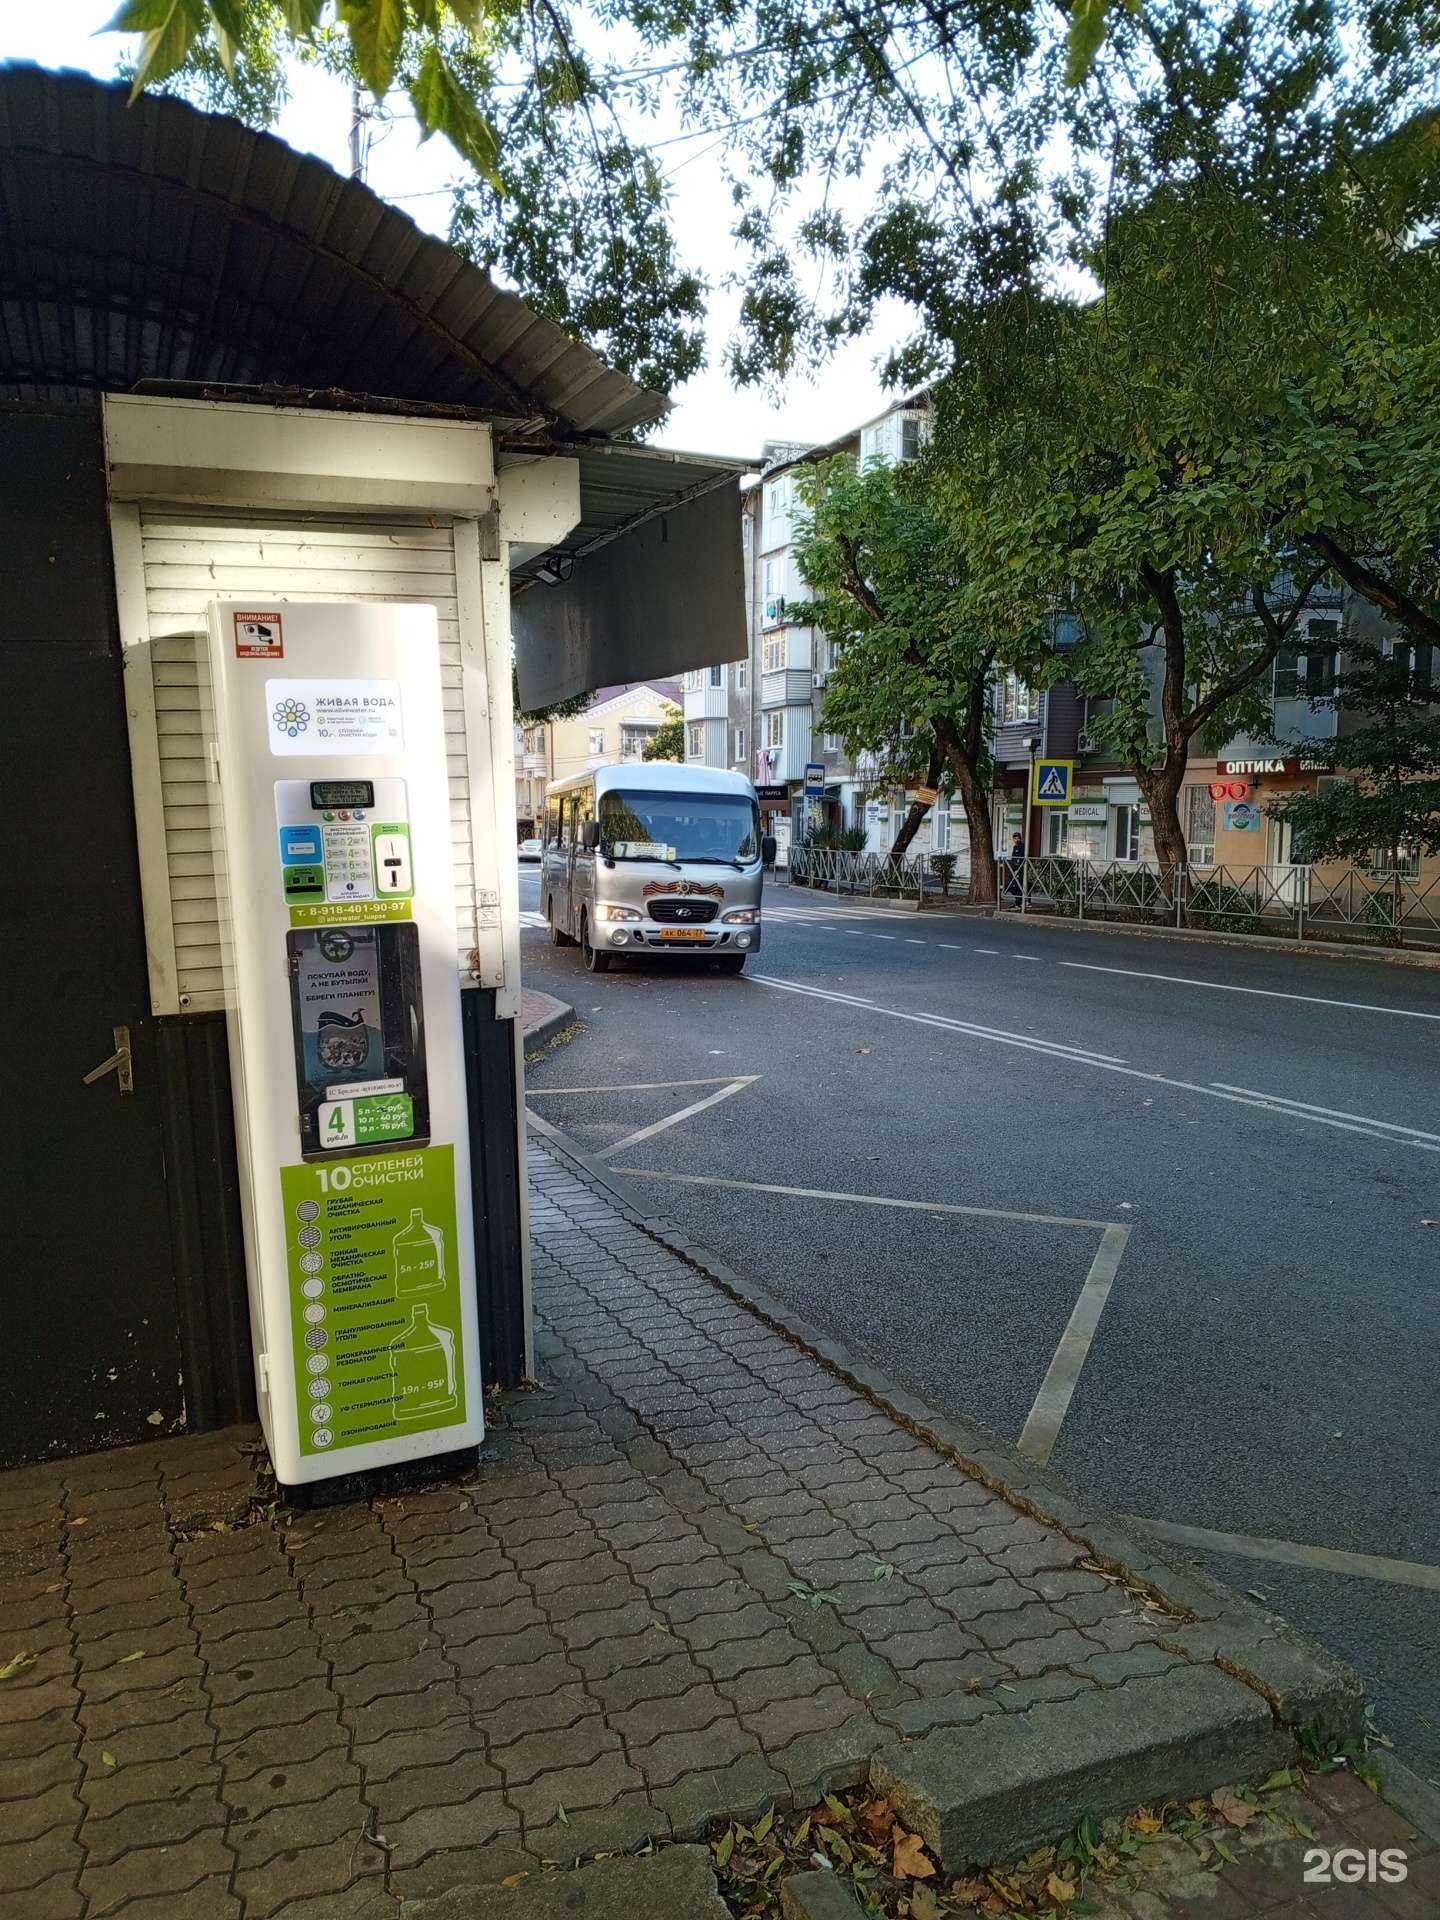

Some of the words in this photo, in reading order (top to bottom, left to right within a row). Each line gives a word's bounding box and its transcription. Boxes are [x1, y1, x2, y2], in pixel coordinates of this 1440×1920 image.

[236, 613, 278, 622] ВНИМАНИЕ!
[316, 698, 358, 707] ЖИВАЯ
[363, 698, 395, 707] ВОДА
[1226, 760, 1285, 774] ОПТИКА
[1074, 807, 1099, 816] MEDICAL
[620, 843, 628, 857] 7
[310, 902, 406, 916] 8-918-401-90-97
[307, 969, 346, 980] ПОКУПАЙ
[347, 969, 371, 977] ВОДУ,
[331, 977, 369, 986] БУТЫЛКИ
[305, 993, 336, 1002] БЕРЕГИ
[337, 990, 375, 999] ПЛАНЕТУ!
[328, 1106, 345, 1133] 4
[380, 1113, 391, 1121] 40
[351, 1155, 423, 1175] СТУПЕНЕЙ
[315, 1166, 351, 1193] 10
[352, 1169, 424, 1188] ОЧИСТКИ
[326, 1196, 353, 1205] ГРУБАЯ
[327, 1198, 383, 1212] МЕХАНИЧЕСКАЯ
[327, 1208, 361, 1218] ОЧИСТКА
[329, 1218, 397, 1234] АКТИВИРОВАННЫЙ
[329, 1233, 352, 1242] УГОЛЬ
[330, 1247, 358, 1257] ТОНКАЯ
[330, 1249, 386, 1263] МЕХАНИЧЕСКАЯ
[330, 1259, 364, 1269] ОЧИСТКА
[331, 1271, 366, 1282] ОБРАТНО-
[331, 1273, 387, 1288] ОСМОТИЧЕСКАЯ
[332, 1284, 372, 1294] МЕМБРАНА
[333, 1297, 395, 1312] МИНЕРАЛИЗАЦИЯ
[334, 1318, 406, 1335] ГРАНУЛИРОВАННЫЙ
[335, 1334, 358, 1342] УГОЛЬ
[336, 1342, 406, 1360] БИОКЕРАМИЧЕСКИЙ
[336, 1355, 377, 1366] РЕЗОНАТОР
[338, 1378, 366, 1388] ТОНКАЯ
[366, 1372, 398, 1383] ОЧИСТКА
[402, 1385, 419, 1395] 19л
[351, 1395, 404, 1410] СТЕРИЛИЗАТОР
[341, 1421, 397, 1437] ОЗОНИРОВАНИЕ
